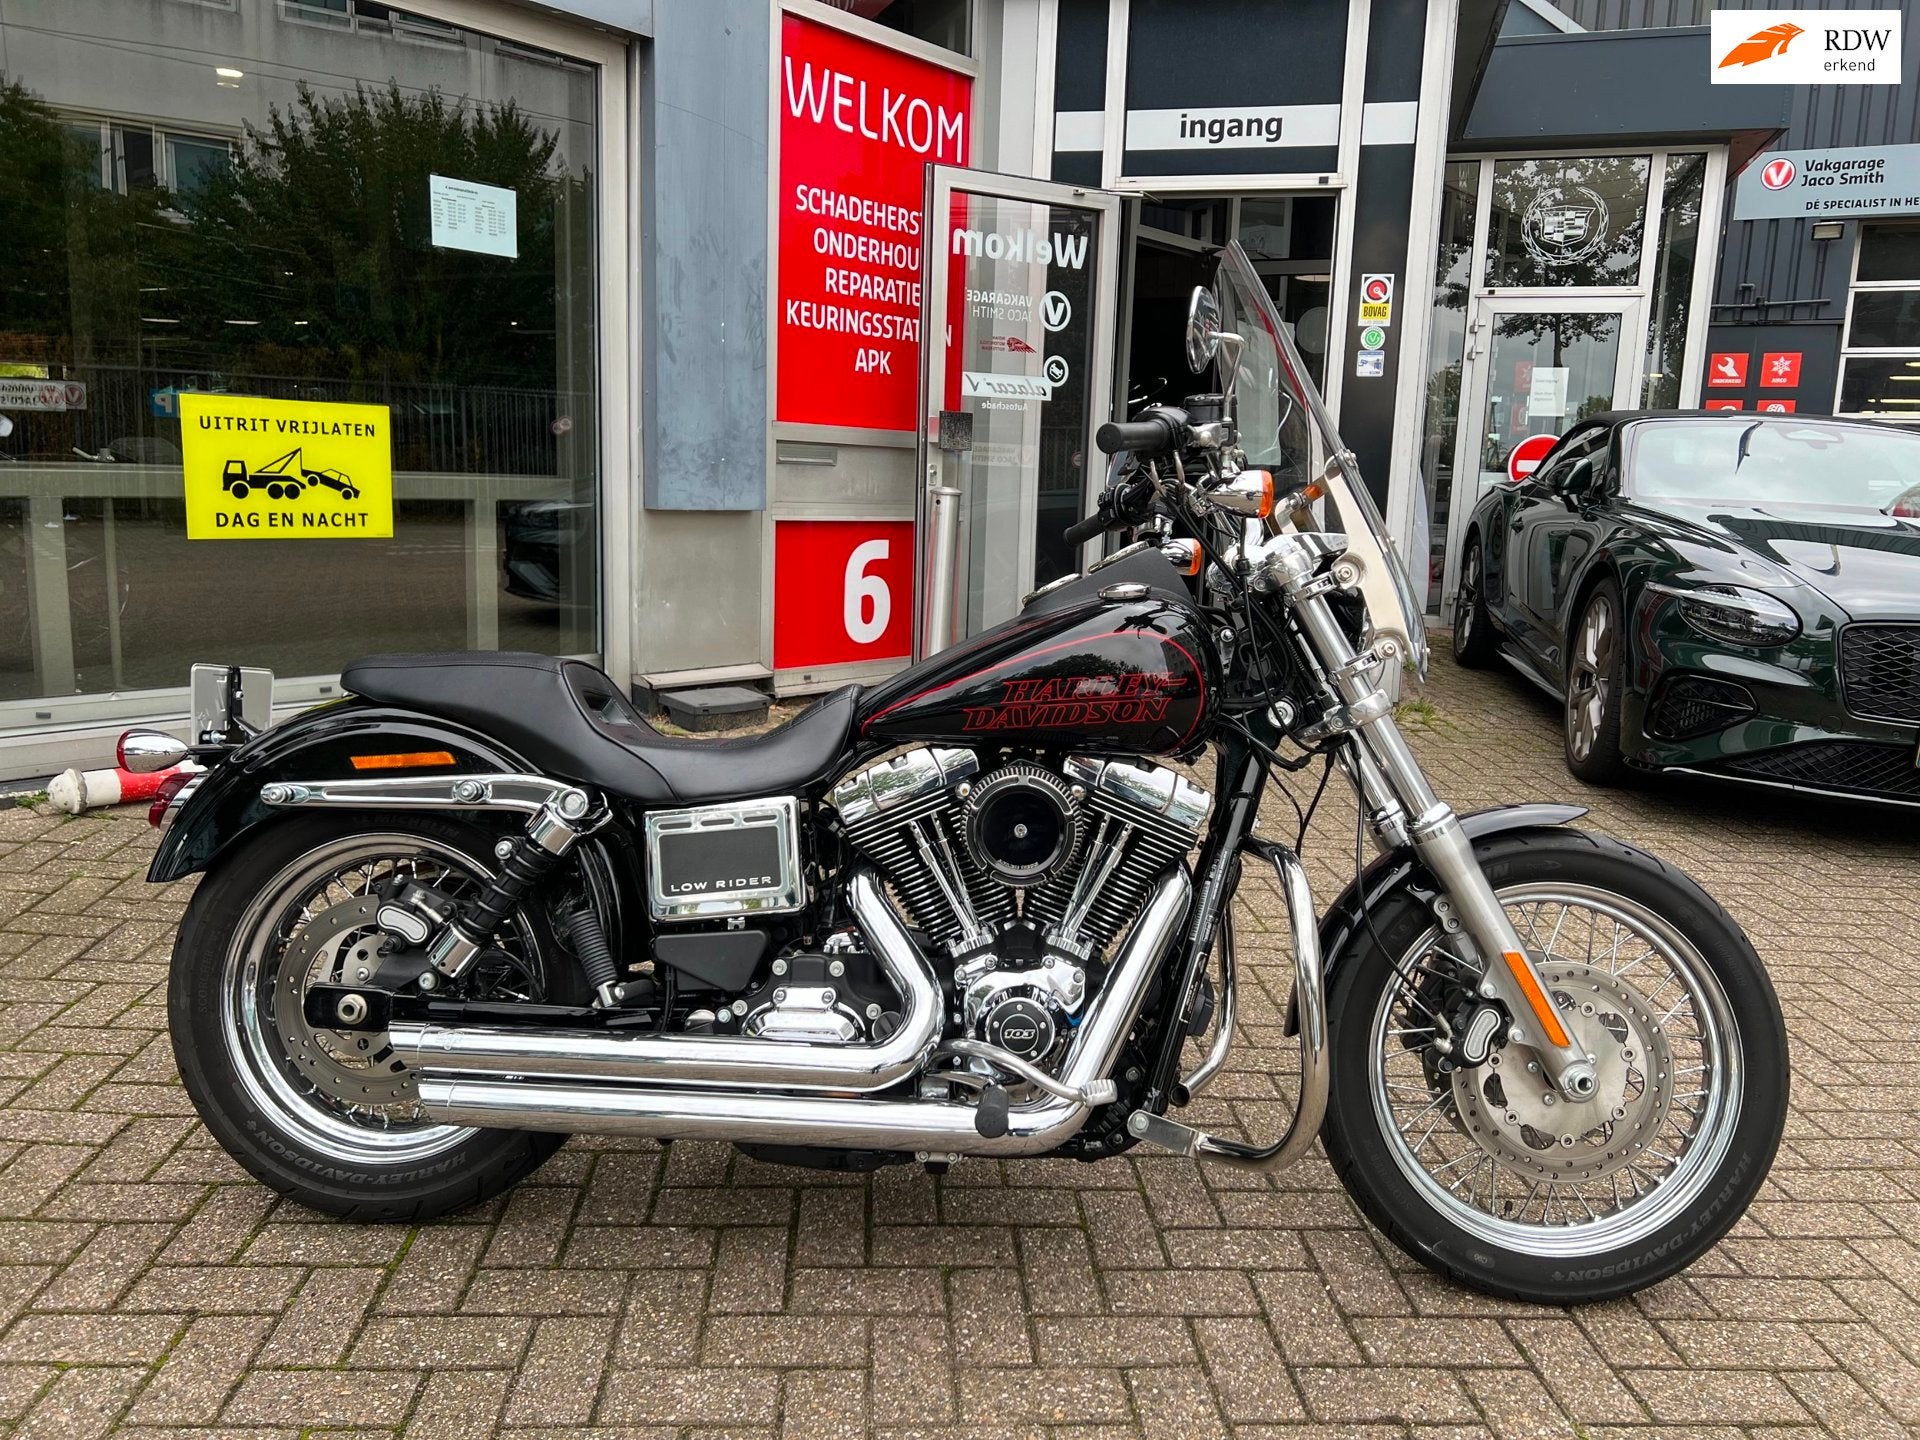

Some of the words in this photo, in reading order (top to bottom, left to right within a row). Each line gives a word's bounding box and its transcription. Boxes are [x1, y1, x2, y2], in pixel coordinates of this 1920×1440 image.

[784, 55, 964, 163] WELKOM
[1180, 113, 1283, 144] ingang
[1801, 174, 1835, 187] Jaco
[1839, 171, 1884, 185] Smith
[1805, 158, 1885, 173] Vakgarage
[795, 184, 922, 235] SCHADEHERS
[1805, 199, 1820, 210] DÉ
[1823, 198, 1886, 210] SPECIALIST
[1890, 197, 1901, 207] IN
[814, 227, 920, 271] ONDERHOU
[825, 267, 921, 307] REPARATIE
[787, 299, 952, 347] KEURINGSSTATN
[1363, 306, 1387, 317] BOVAG
[855, 348, 892, 375] APK
[199, 415, 270, 432] UITRIT
[276, 419, 376, 437] VRIJLATEN
[215, 512, 260, 528] DAG
[268, 512, 294, 528] EN
[302, 512, 369, 528] NACHT
[843, 539, 891, 644] 6
[962, 697, 1172, 731] DAVIDSON
[670, 881, 708, 892] LOW
[715, 876, 772, 889] RIDER
[1003, 1028, 1036, 1039] 103
